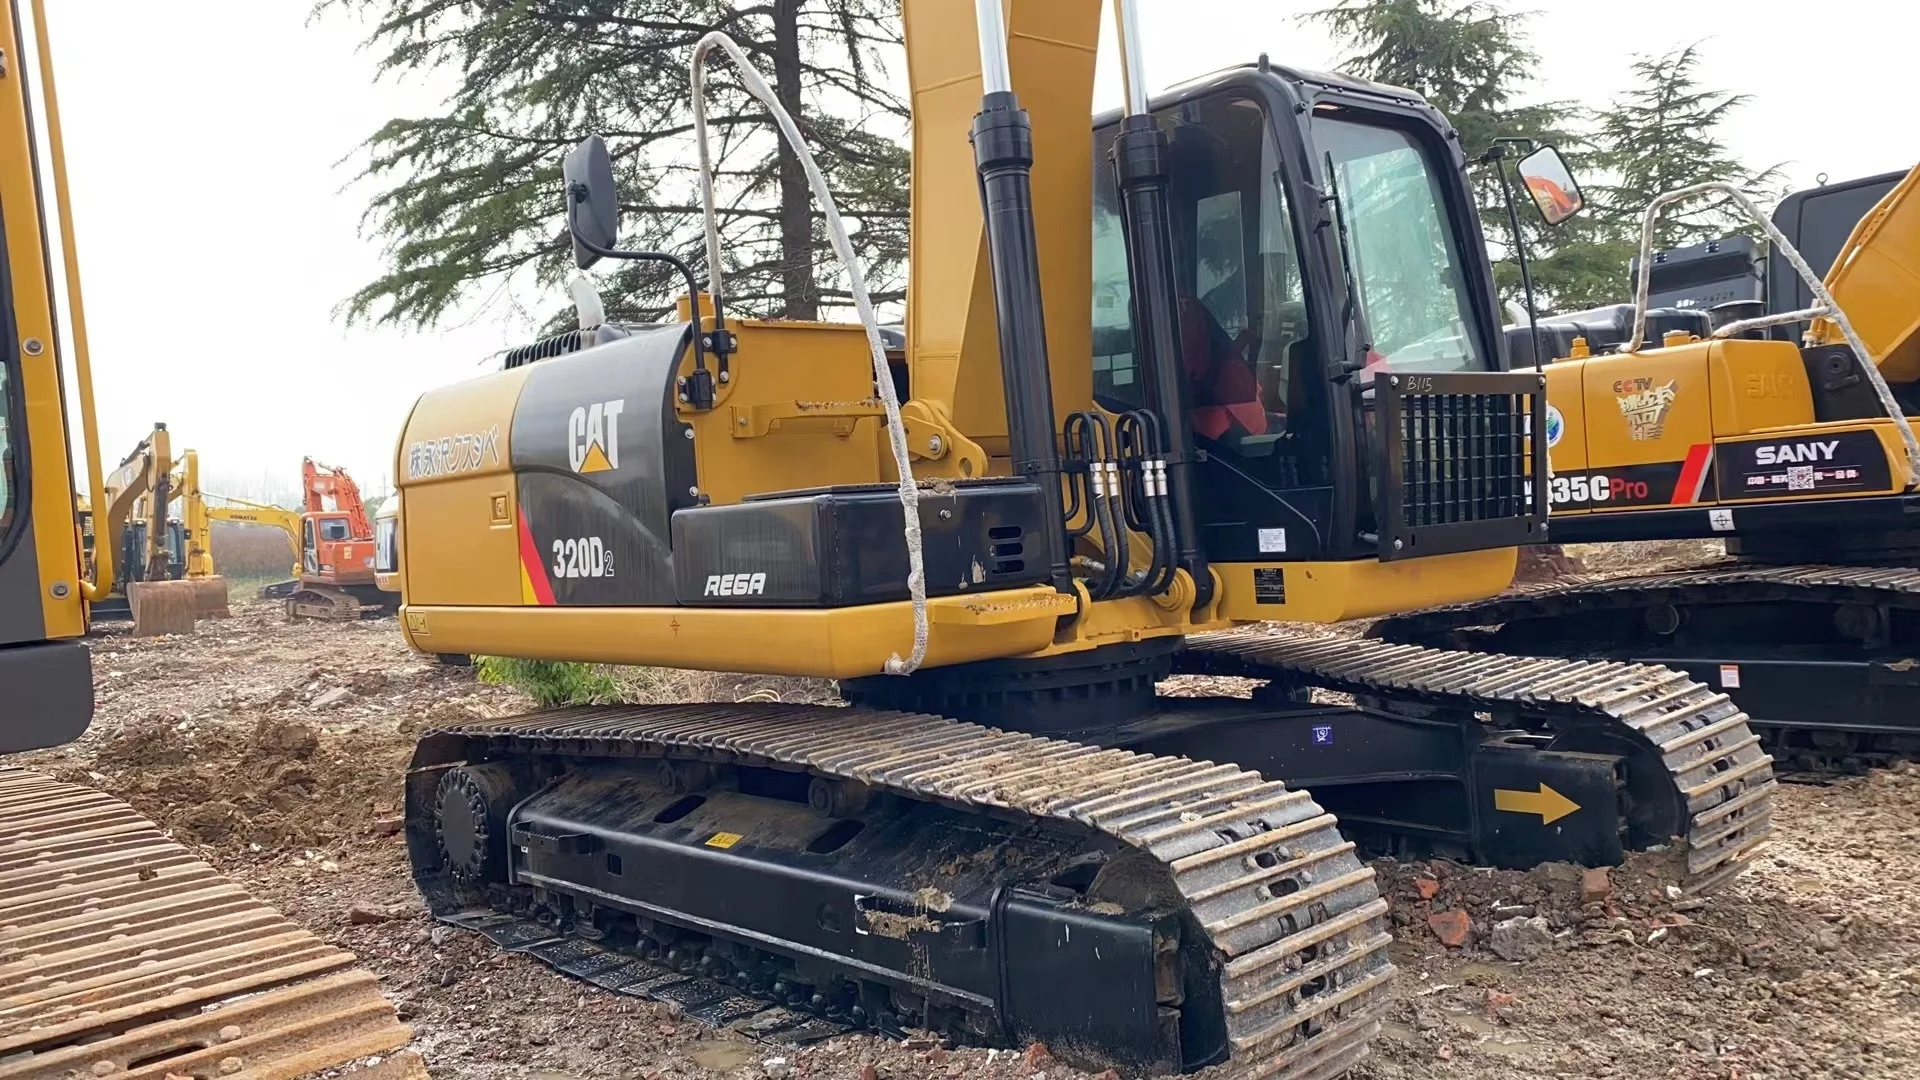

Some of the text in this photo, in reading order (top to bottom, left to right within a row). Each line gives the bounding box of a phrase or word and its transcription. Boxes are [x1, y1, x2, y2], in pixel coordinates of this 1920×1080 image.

[1406, 375, 1433, 393] B115
[1613, 377, 1653, 393] CCTV
[568, 399, 625, 474] CAT
[1755, 440, 1840, 465] SANY
[704, 572, 767, 597] REGA
